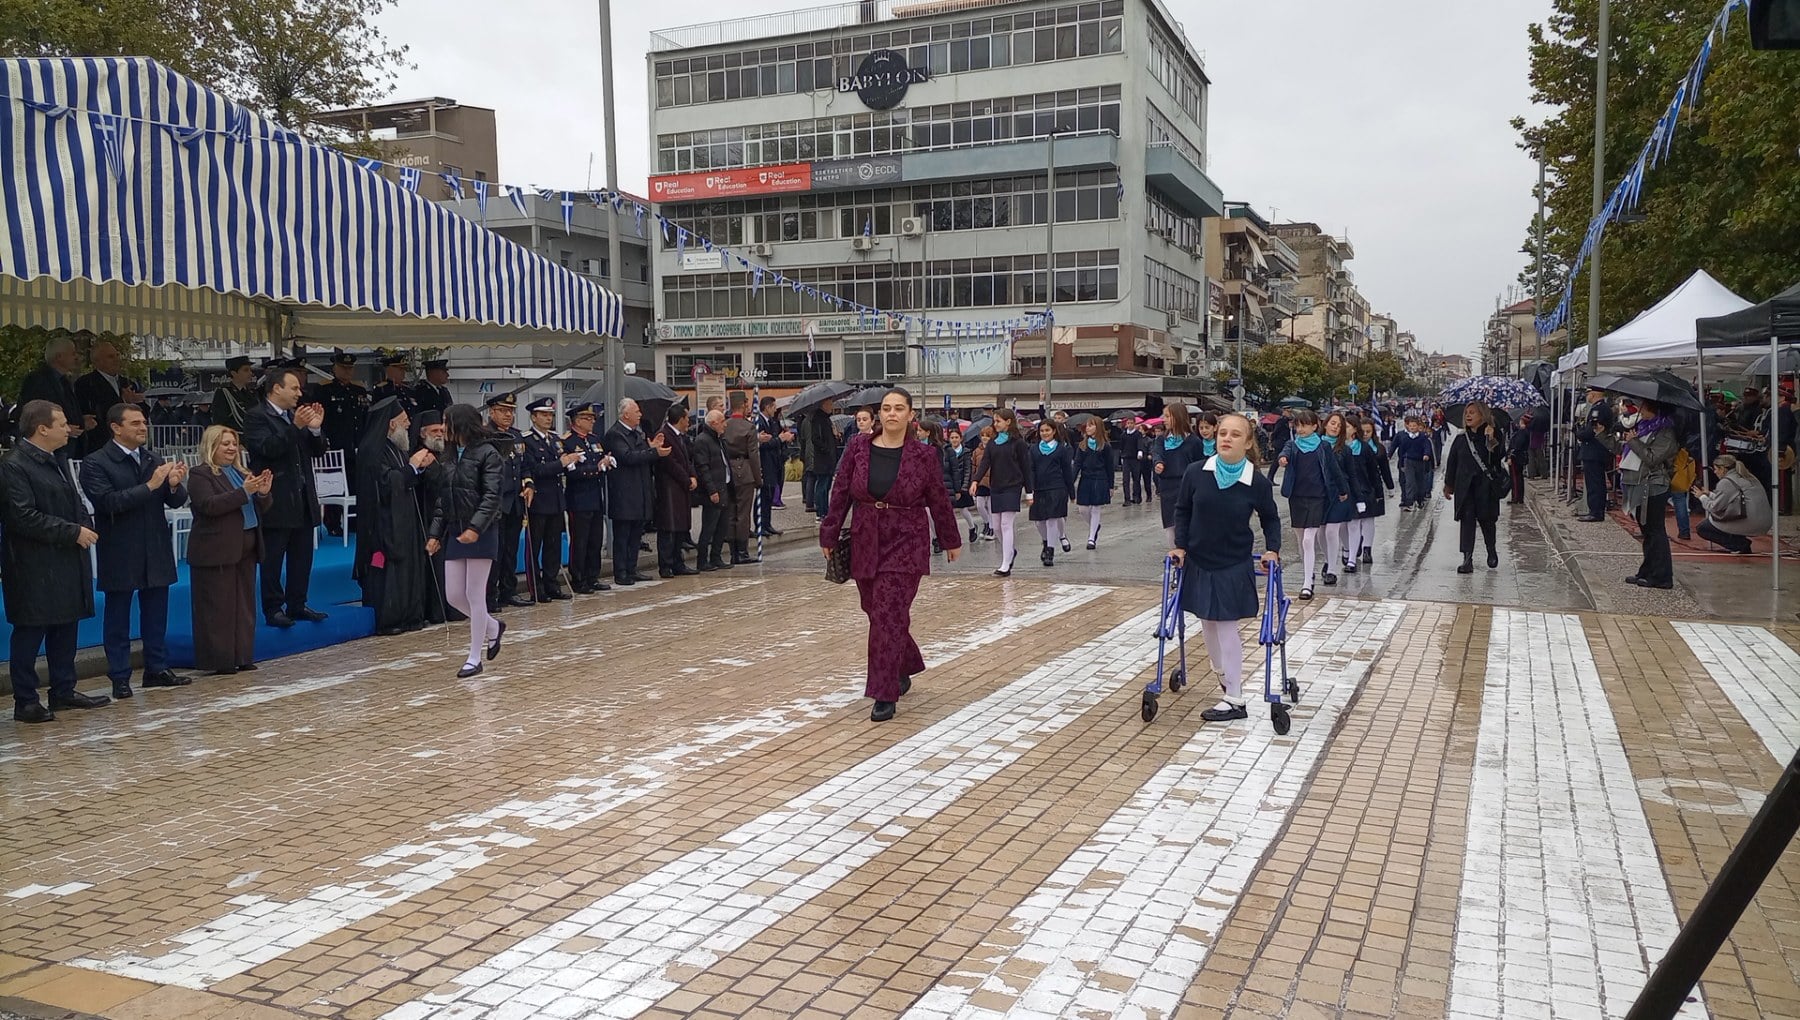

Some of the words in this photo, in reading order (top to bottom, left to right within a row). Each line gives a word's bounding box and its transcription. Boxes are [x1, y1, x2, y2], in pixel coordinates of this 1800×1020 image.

[839, 69, 926, 92] BABYLON
[875, 165, 898, 175] ECDL
[714, 175, 731, 185] Real
[767, 171, 785, 180] Real
[663, 180, 679, 189] Real
[771, 177, 802, 186] Education
[666, 187, 695, 195] Education
[718, 183, 747, 191] Education
[739, 367, 768, 378] coffee
[1051, 401, 1100, 409] ΥΣΤΑΚΙΔΗΣ
